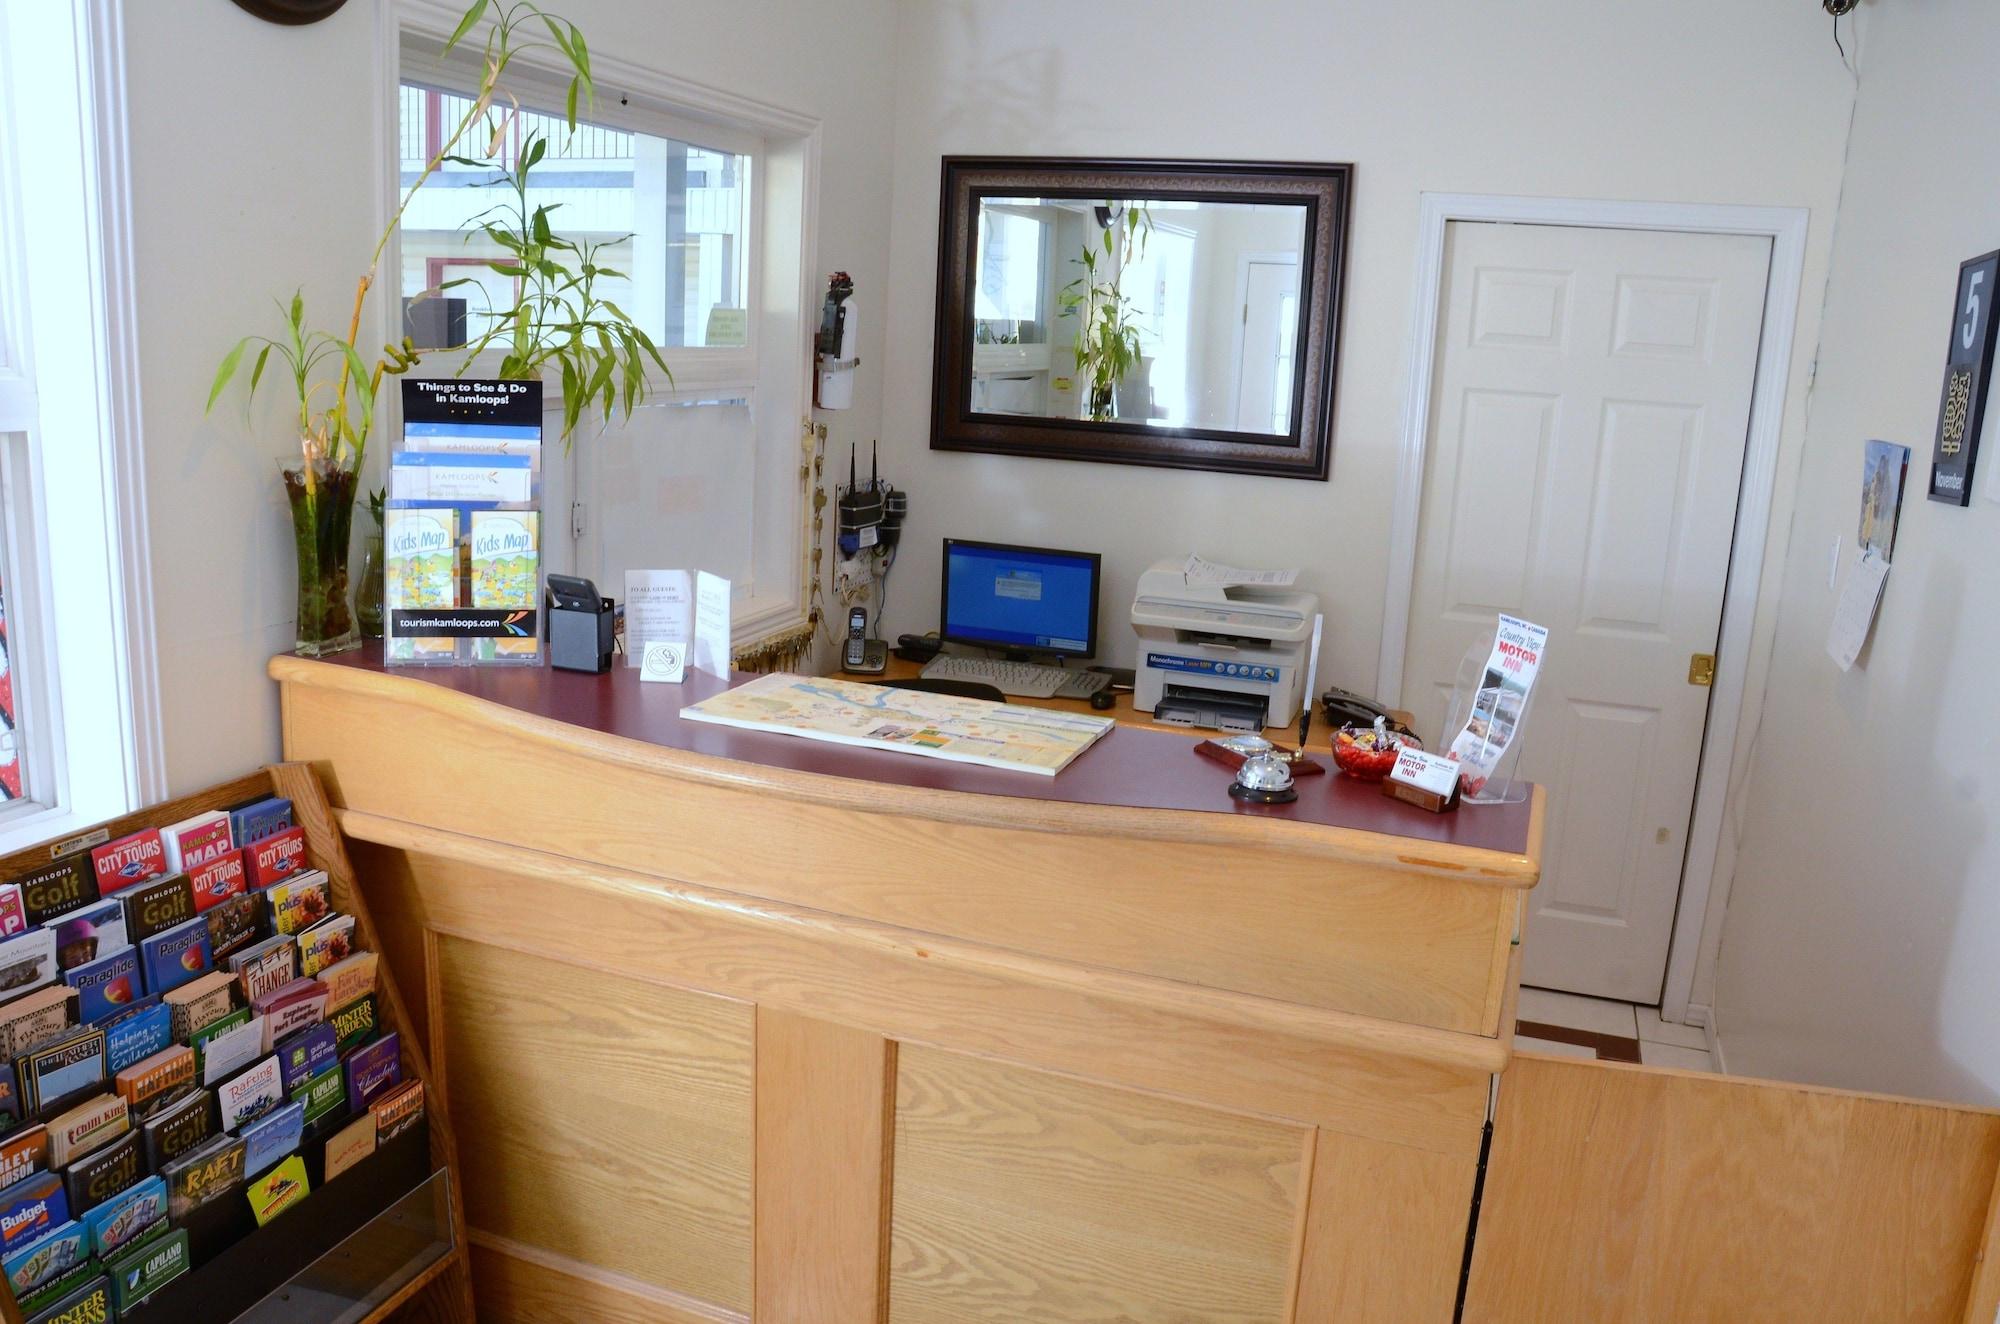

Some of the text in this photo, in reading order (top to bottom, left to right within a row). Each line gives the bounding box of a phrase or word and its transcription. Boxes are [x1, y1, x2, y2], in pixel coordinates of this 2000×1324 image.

[1962, 270, 1985, 350] 5
[417, 382, 527, 393] Things to See & Do
[436, 394, 509, 406] in Kamloops!
[1936, 471, 1963, 490] November
[393, 531, 445, 553] Kids Map
[476, 533, 528, 555] Kids Map
[400, 617, 499, 629] tourismkamloops.com
[1500, 627, 1541, 651] Country View
[1150, 655, 1184, 666] Monochrome
[1498, 640, 1537, 665] MOTOR
[1502, 656, 1522, 672] INN
[1399, 758, 1426, 772] MOTOR
[1402, 768, 1417, 778] INN
[182, 828, 226, 850] KAMLOOPS
[98, 851, 124, 875] CITY
[124, 839, 161, 863] TOURS
[185, 839, 228, 867] MAP
[259, 836, 303, 868] CITY TOURS
[26, 866, 72, 887] KAMLOOPS
[193, 858, 242, 893] CITY TOURS
[27, 873, 80, 911] Golf
[144, 885, 182, 902] KAMLOOPS
[144, 891, 187, 926] Golf
[278, 894, 301, 916] plus
[160, 927, 206, 957] Paraglide
[305, 939, 328, 960] plus
[78, 960, 135, 987] Paraglide
[253, 963, 291, 1001] CHANGE
[332, 1000, 372, 1028] MINTER
[110, 1027, 148, 1049] Helping
[112, 1043, 160, 1072] Children
[312, 1074, 339, 1099] CAPILANO
[104, 1103, 126, 1121] King
[164, 1106, 203, 1133] KAMLOOPS
[163, 1113, 207, 1153] Golf
[90, 1147, 133, 1177] KAMLOOPS
[186, 1149, 243, 1194] RAFT
[0, 1160, 34, 1190] IDSON
[88, 1153, 137, 1198] Golf
[1, 1200, 47, 1231] Budget
[62, 1261, 88, 1279] INSTANT
[145, 1241, 182, 1274] CAPILANO
